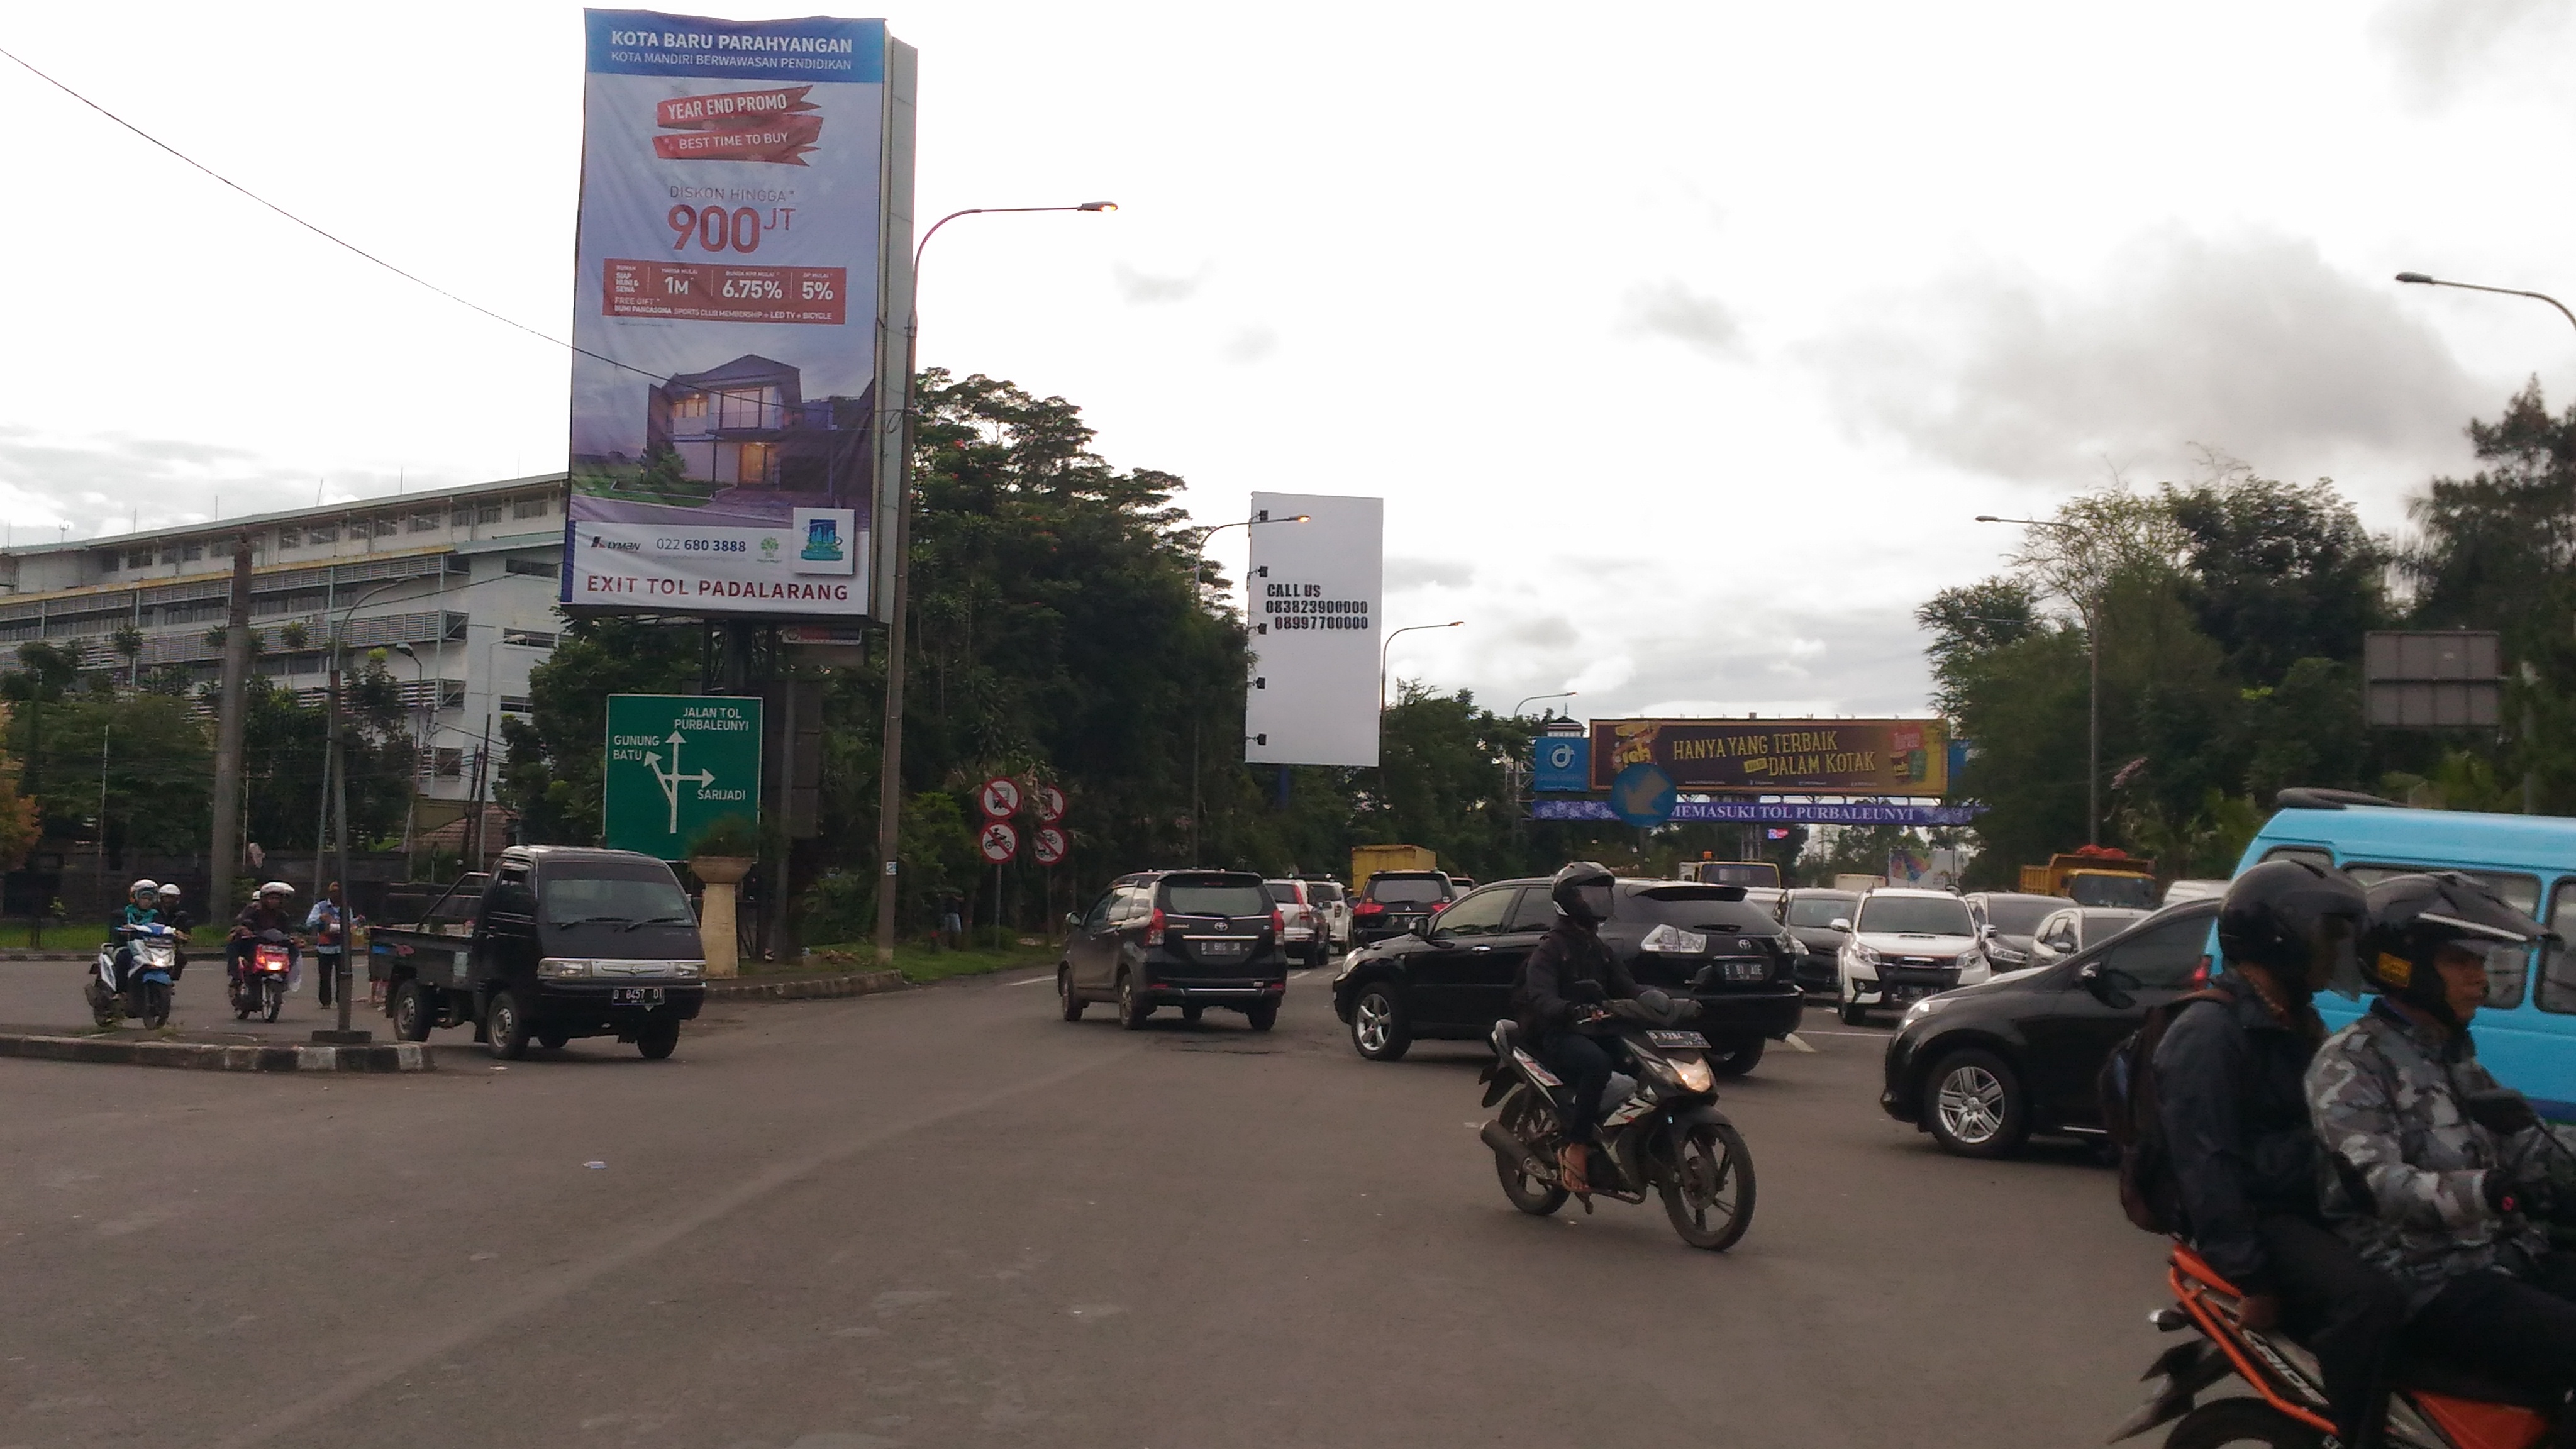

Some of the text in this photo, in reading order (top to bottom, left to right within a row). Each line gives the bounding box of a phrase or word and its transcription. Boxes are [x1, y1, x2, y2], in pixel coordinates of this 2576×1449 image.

[611, 31, 852, 53] KOTA BARU PARAHYANGAN
[611, 52, 851, 69] KOTA MANDIRI BERWAWASAN PENDIDIKAN
[667, 94, 787, 119] YEAR END PROMO
[679, 133, 788, 150] BEST TIME TO BUY
[670, 186, 724, 200] DISKON
[668, 204, 796, 253] 900 JT
[722, 279, 783, 299] 6.75%
[802, 281, 833, 300] 5%
[674, 308, 699, 316] SPORTS
[657, 538, 746, 552] 022 680 3888
[587, 575, 848, 601] EXIT TOL PADALARANG
[1267, 584, 1321, 597] CALL US
[683, 708, 742, 718] JALAN TOL
[674, 719, 749, 731] PURBALEUNYI
[614, 735, 660, 747] GUNUNG
[1674, 731, 1837, 760] HANYA YANG TERBAIK
[613, 749, 642, 760] BATU
[1768, 755, 1820, 776] DALAM
[1826, 752, 1875, 774] KOTAK
[697, 789, 745, 800] SARIJADI
[1759, 806, 1792, 819] TOL
[1797, 808, 1914, 821] PURBALEUNYI
